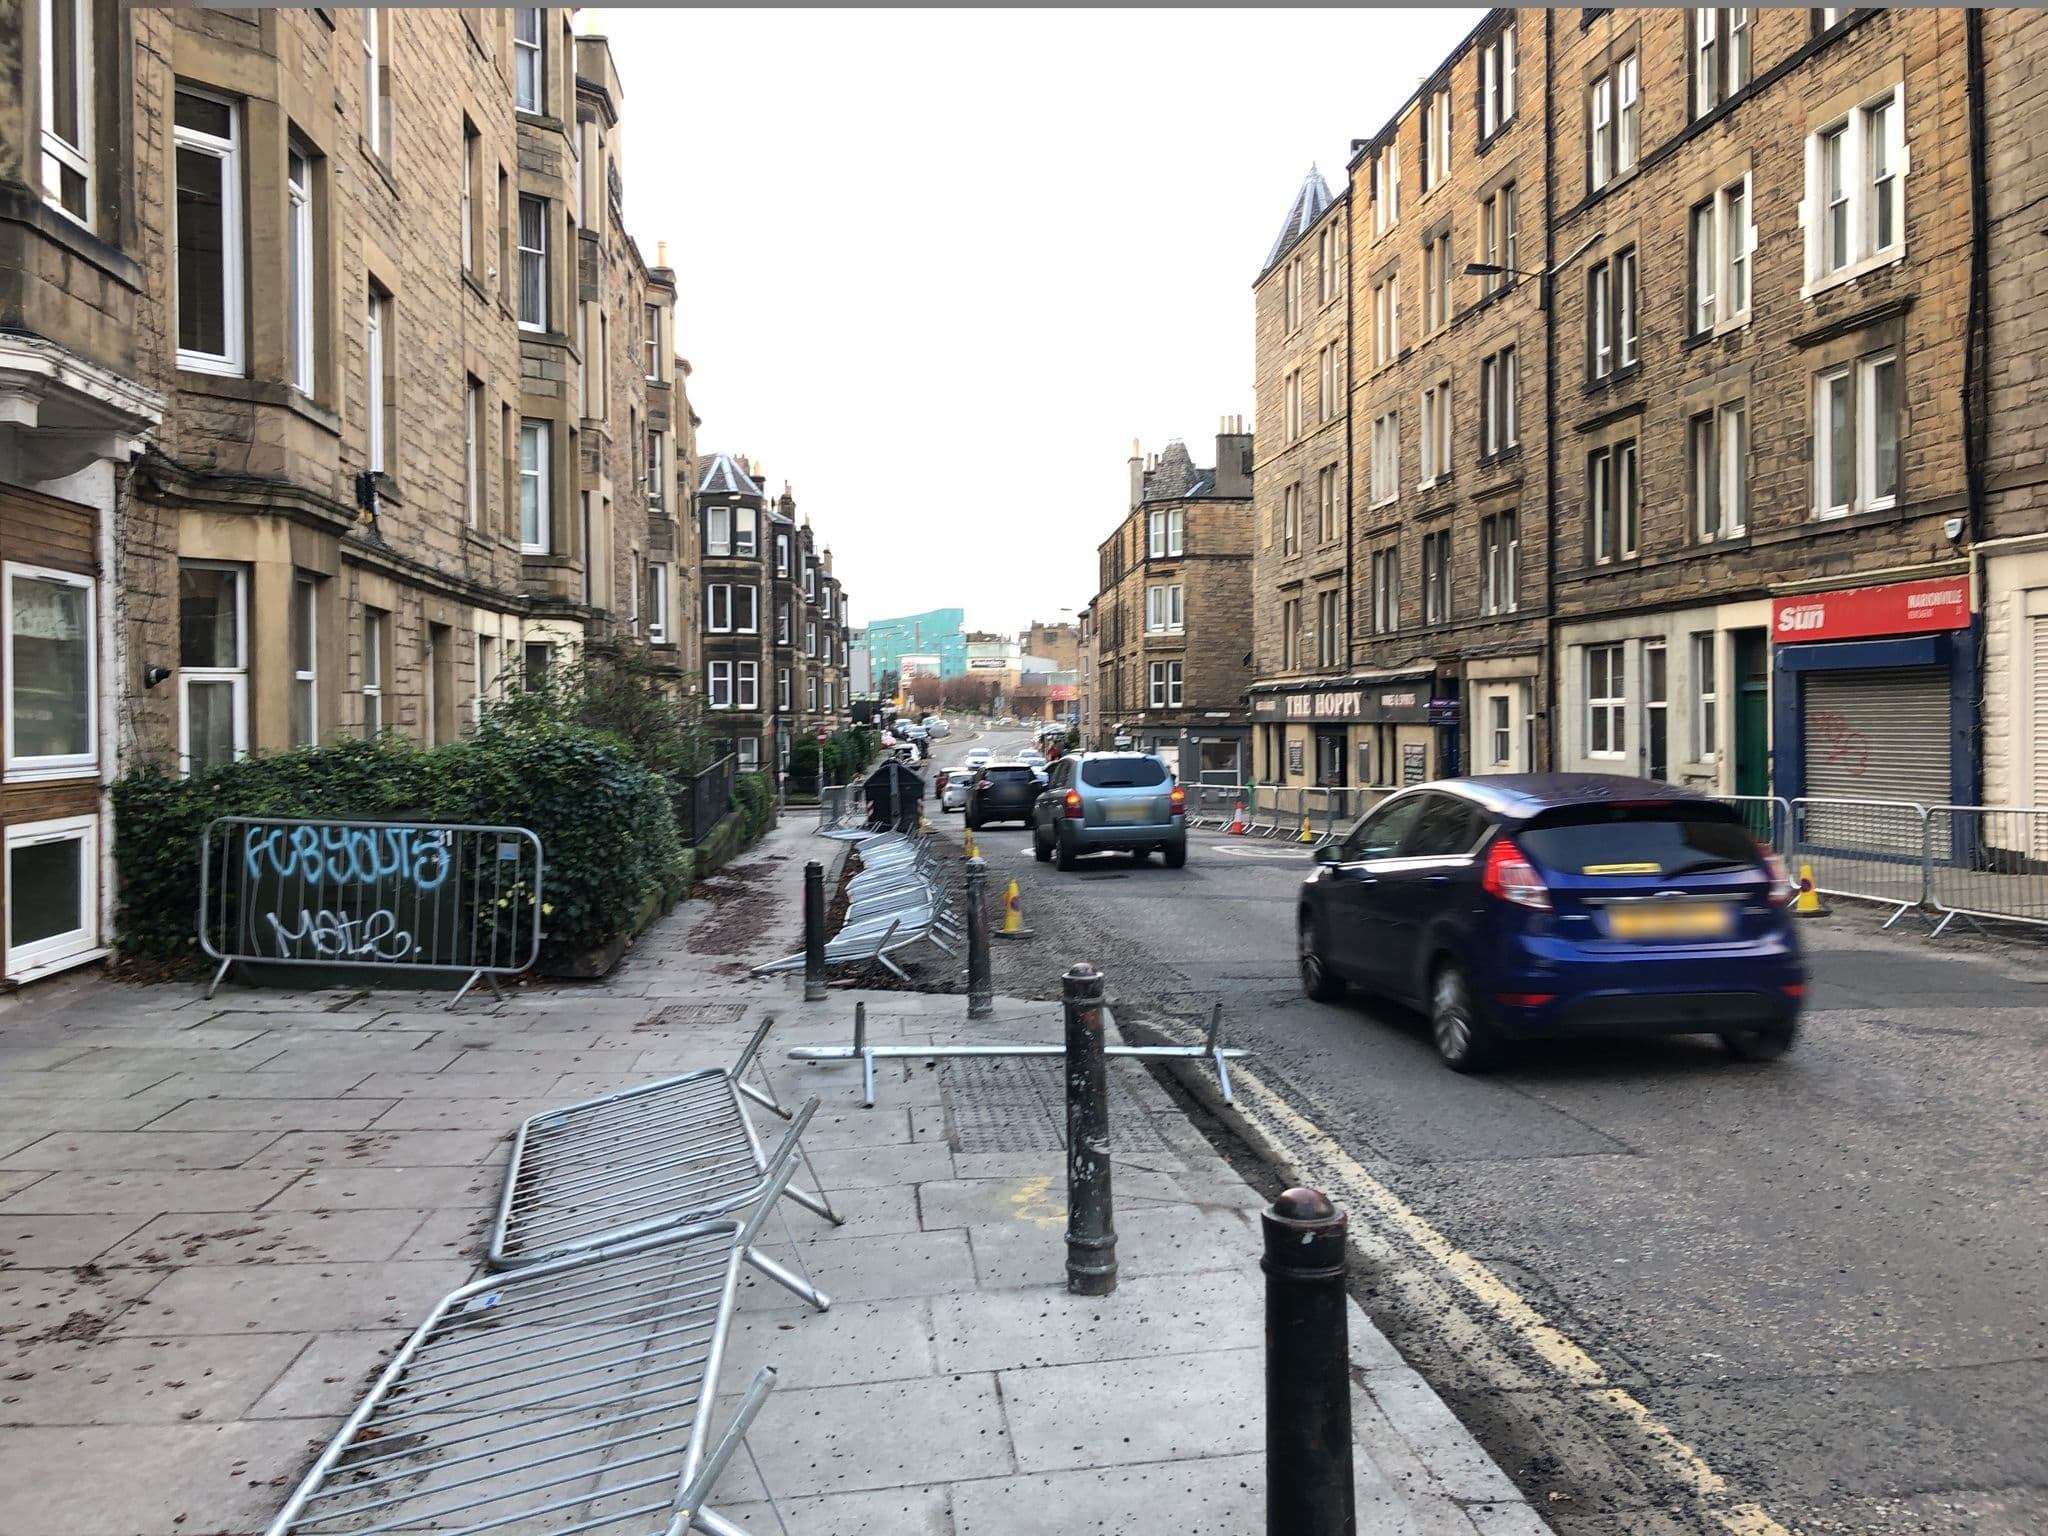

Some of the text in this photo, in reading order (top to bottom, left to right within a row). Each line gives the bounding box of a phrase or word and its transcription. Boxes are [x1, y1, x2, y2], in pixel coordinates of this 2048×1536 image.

[1778, 607, 1826, 632] Sun
[1286, 694, 1312, 717] THE
[1315, 692, 1363, 717] HOPPY
